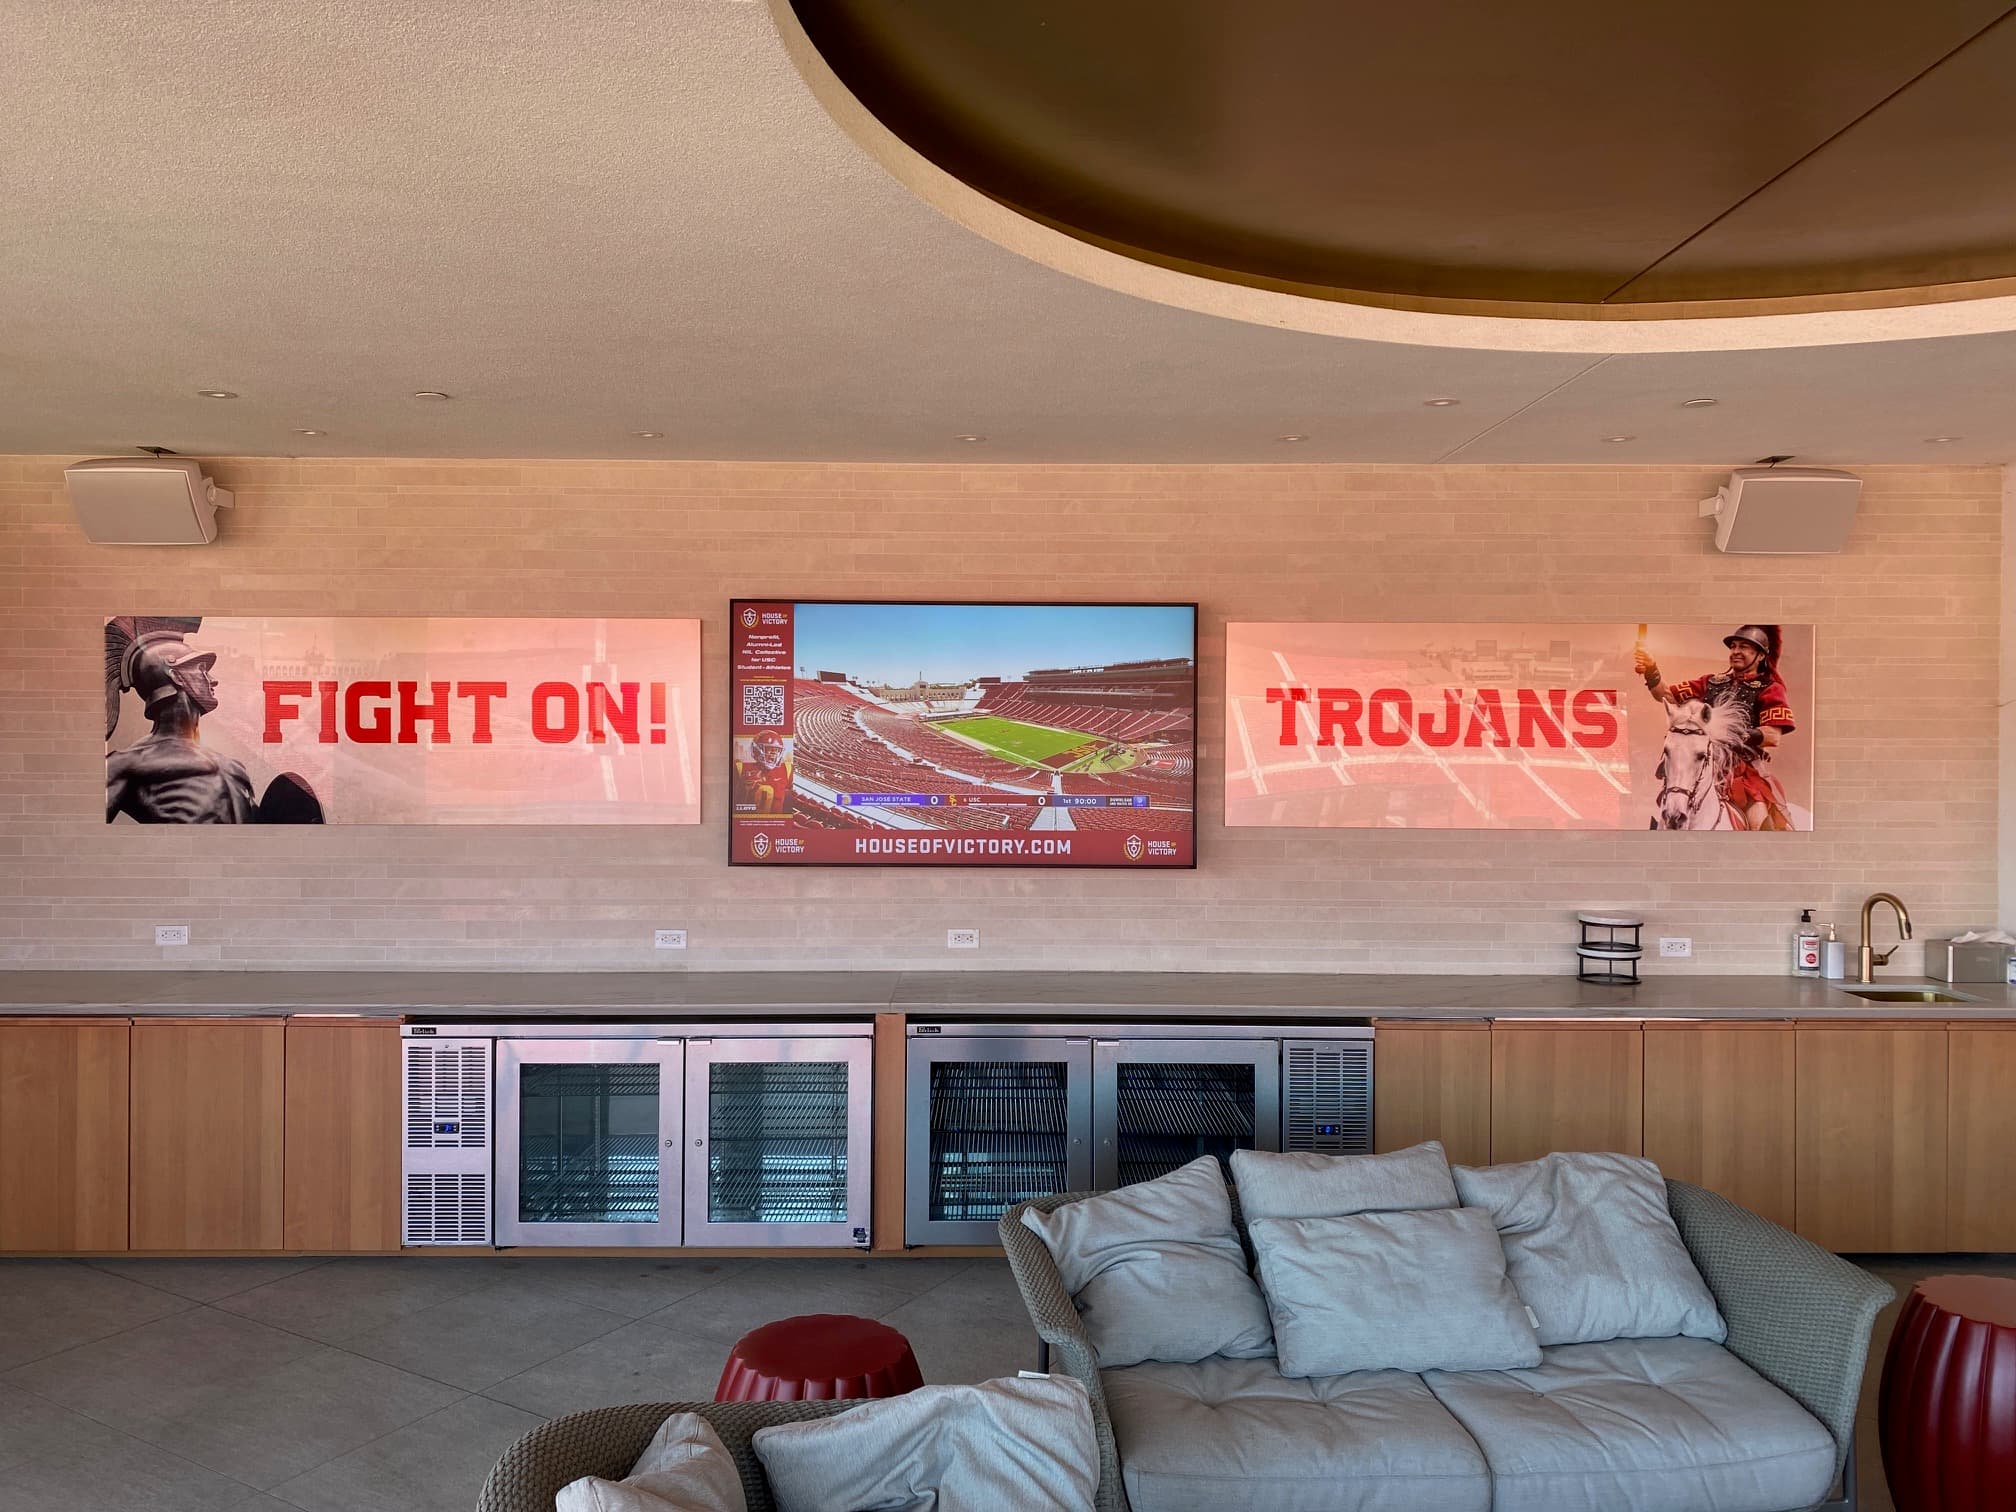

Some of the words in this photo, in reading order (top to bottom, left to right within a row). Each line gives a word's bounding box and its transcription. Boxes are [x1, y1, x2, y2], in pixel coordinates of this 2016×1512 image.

[262, 680, 507, 744] FIGHT
[531, 680, 666, 744] ON!
[1266, 687, 1618, 748] TROJANS
[930, 795, 939, 805] 0
[1038, 796, 1046, 806] 0
[775, 838, 798, 846] HOUSE
[855, 838, 1071, 855] HOUSEOFVICTORY.COM
[1147, 840, 1171, 848] HOUSE
[775, 846, 805, 854] VICTORY
[1147, 848, 1177, 856] VICTORY
